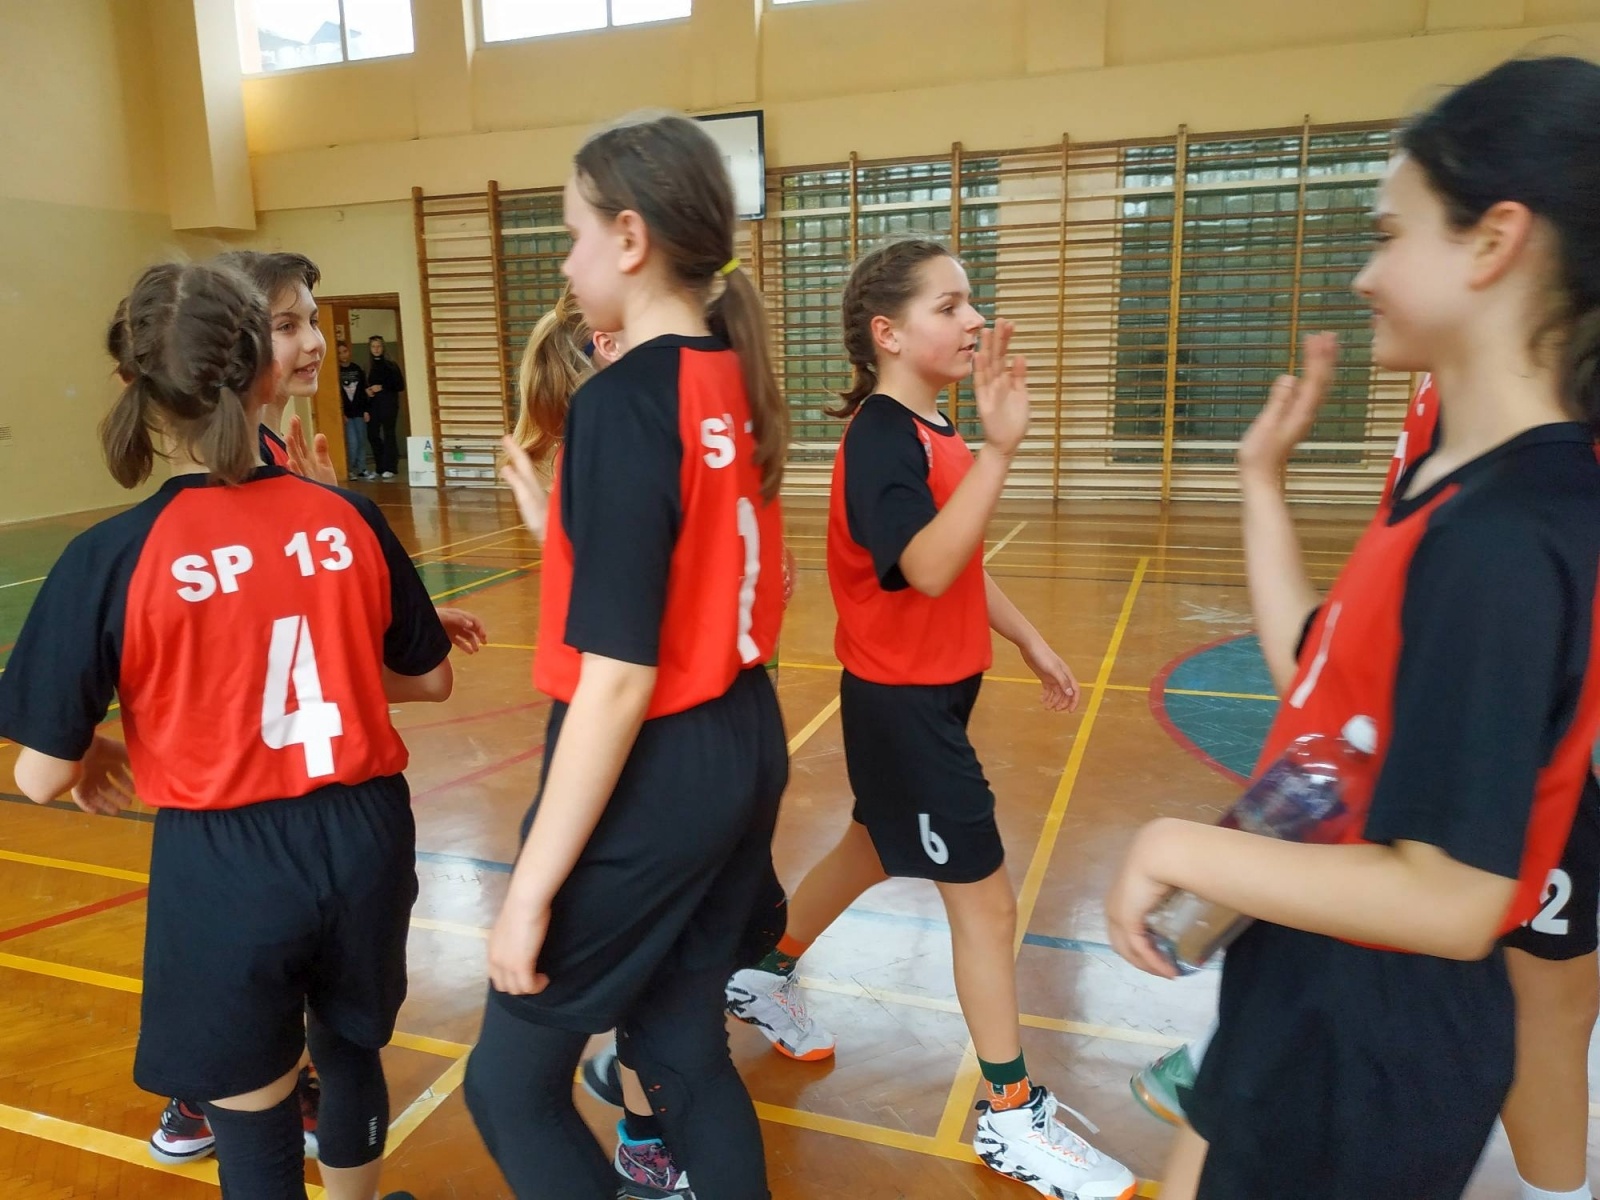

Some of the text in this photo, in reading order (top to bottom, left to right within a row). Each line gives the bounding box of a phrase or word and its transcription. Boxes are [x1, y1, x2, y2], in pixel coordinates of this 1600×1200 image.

[700, 413, 737, 469] S
[171, 527, 353, 602] SP 13
[261, 615, 343, 778] 4
[918, 813, 949, 865] 6
[1521, 868, 1572, 935] 2
